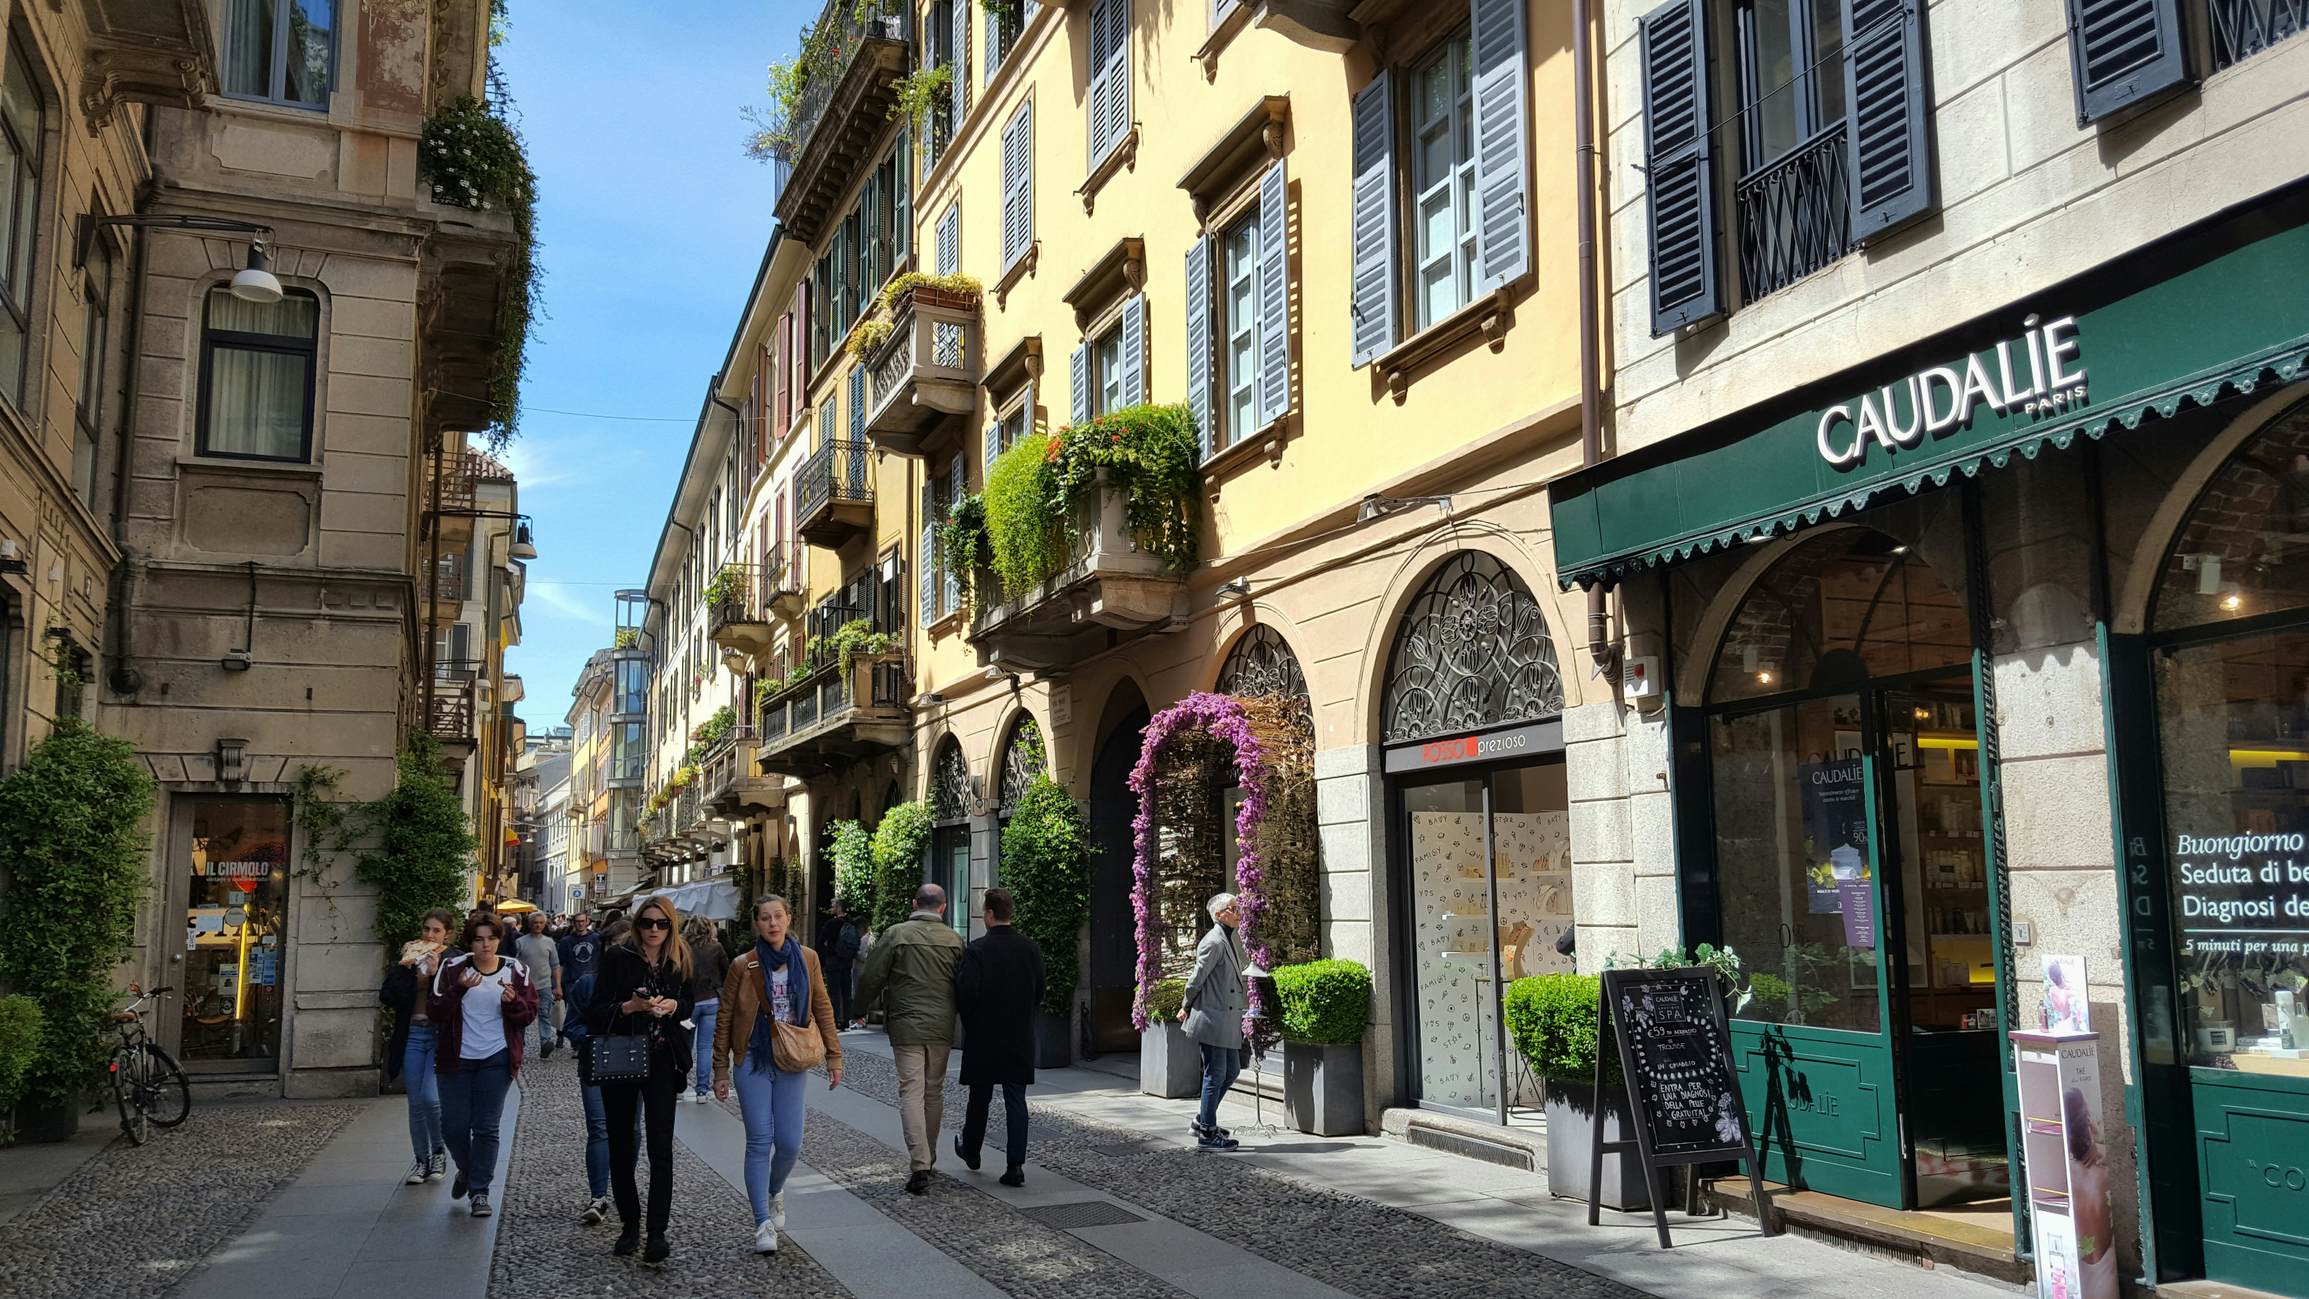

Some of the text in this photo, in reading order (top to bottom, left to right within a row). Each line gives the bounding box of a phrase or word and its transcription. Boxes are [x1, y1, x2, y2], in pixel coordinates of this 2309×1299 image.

[2025, 386, 2086, 415] PARIS
[1478, 735, 1526, 757] prezioso
[2176, 830, 2304, 860] Buongiorno
[206, 861, 269, 876] IL CIRMOLO
[2180, 862, 2253, 884] Seduta
[2260, 860, 2279, 883] di
[2183, 894, 2309, 923] Diagnosi de
[2186, 939, 2194, 951] 5
[2197, 938, 2241, 952] minuti
[2244, 941, 2268, 956] per
[2271, 942, 2299, 953] una
[1658, 1009, 1682, 1020] SPA
[1660, 1081, 1703, 1093] ENTRA PER
[1662, 1088, 1711, 1101] UNA DIAGNOSI
[1664, 1101, 1684, 1110] DELLA
